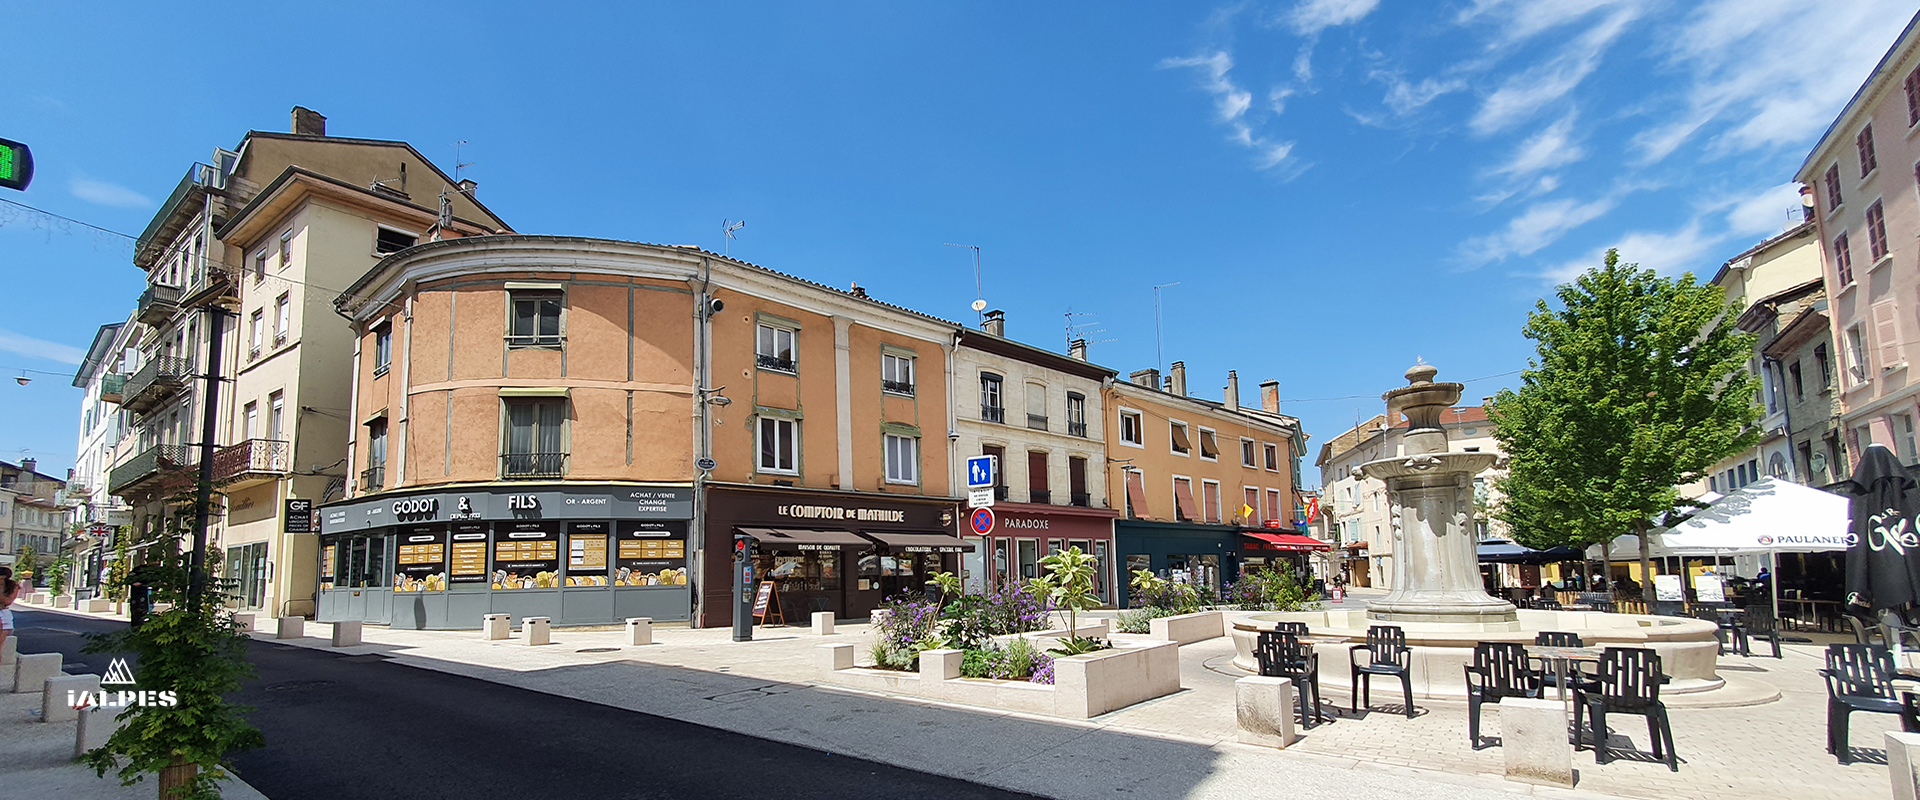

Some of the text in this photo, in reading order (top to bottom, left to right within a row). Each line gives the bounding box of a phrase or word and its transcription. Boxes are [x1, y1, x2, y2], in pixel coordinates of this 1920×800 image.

[290, 501, 308, 511] GF
[392, 495, 537, 515] GODOT & FILS
[778, 505, 904, 522] LE COMPTOIR DE MATHILDE
[1004, 518, 1049, 529] PARADOXE
